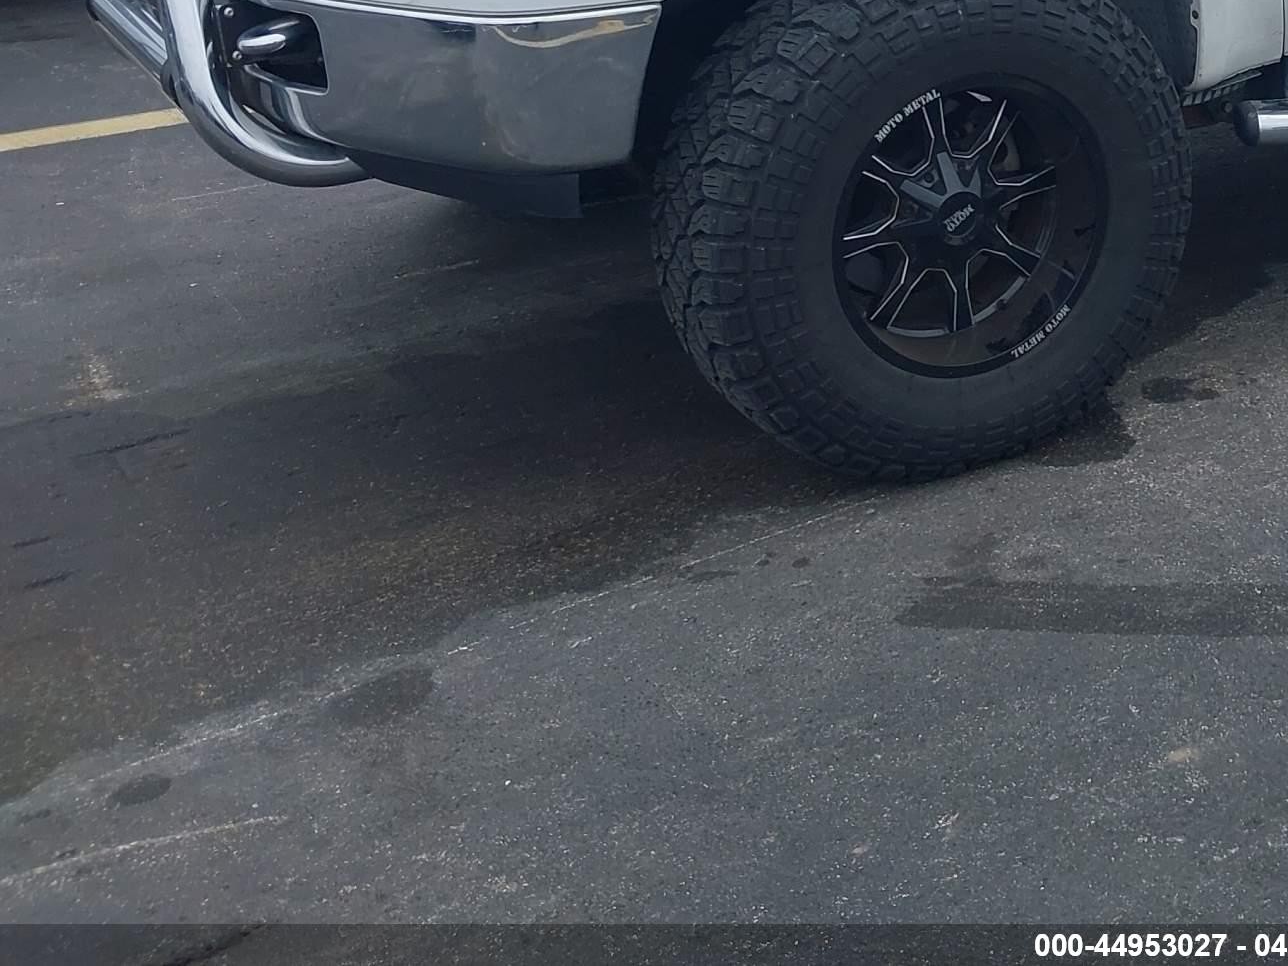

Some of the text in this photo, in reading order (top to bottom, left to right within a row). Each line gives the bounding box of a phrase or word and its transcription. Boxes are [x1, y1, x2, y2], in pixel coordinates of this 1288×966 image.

[874, 89, 941, 143] MOTO METAL
[1010, 304, 1071, 358] MOTO METAL
